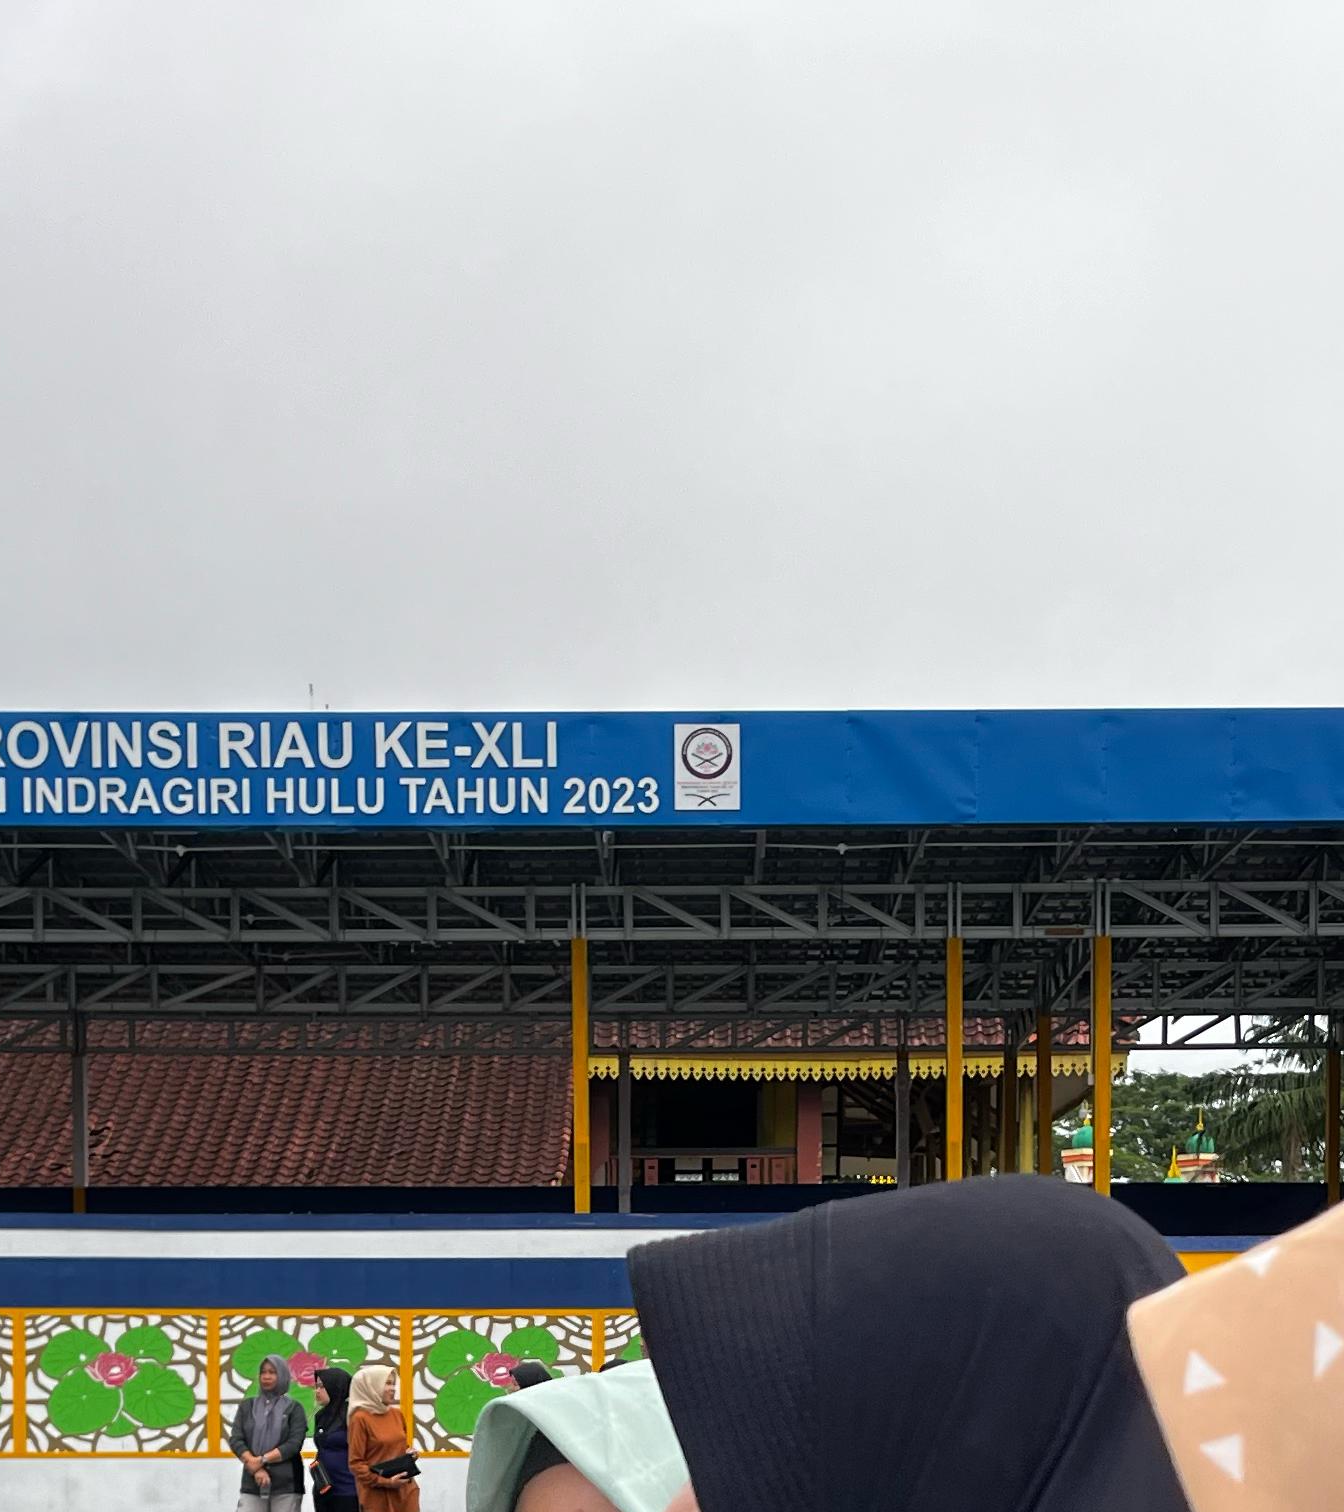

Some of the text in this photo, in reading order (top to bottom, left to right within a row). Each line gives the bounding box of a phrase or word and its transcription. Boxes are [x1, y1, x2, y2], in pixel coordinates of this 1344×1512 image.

[219, 722, 354, 769] RIAU
[375, 722, 557, 769] KE-XLI
[23, 776, 251, 814] INDRAGIRI
[267, 777, 385, 814] HULU
[399, 777, 548, 814] TAHUN
[563, 777, 660, 814] 2023
